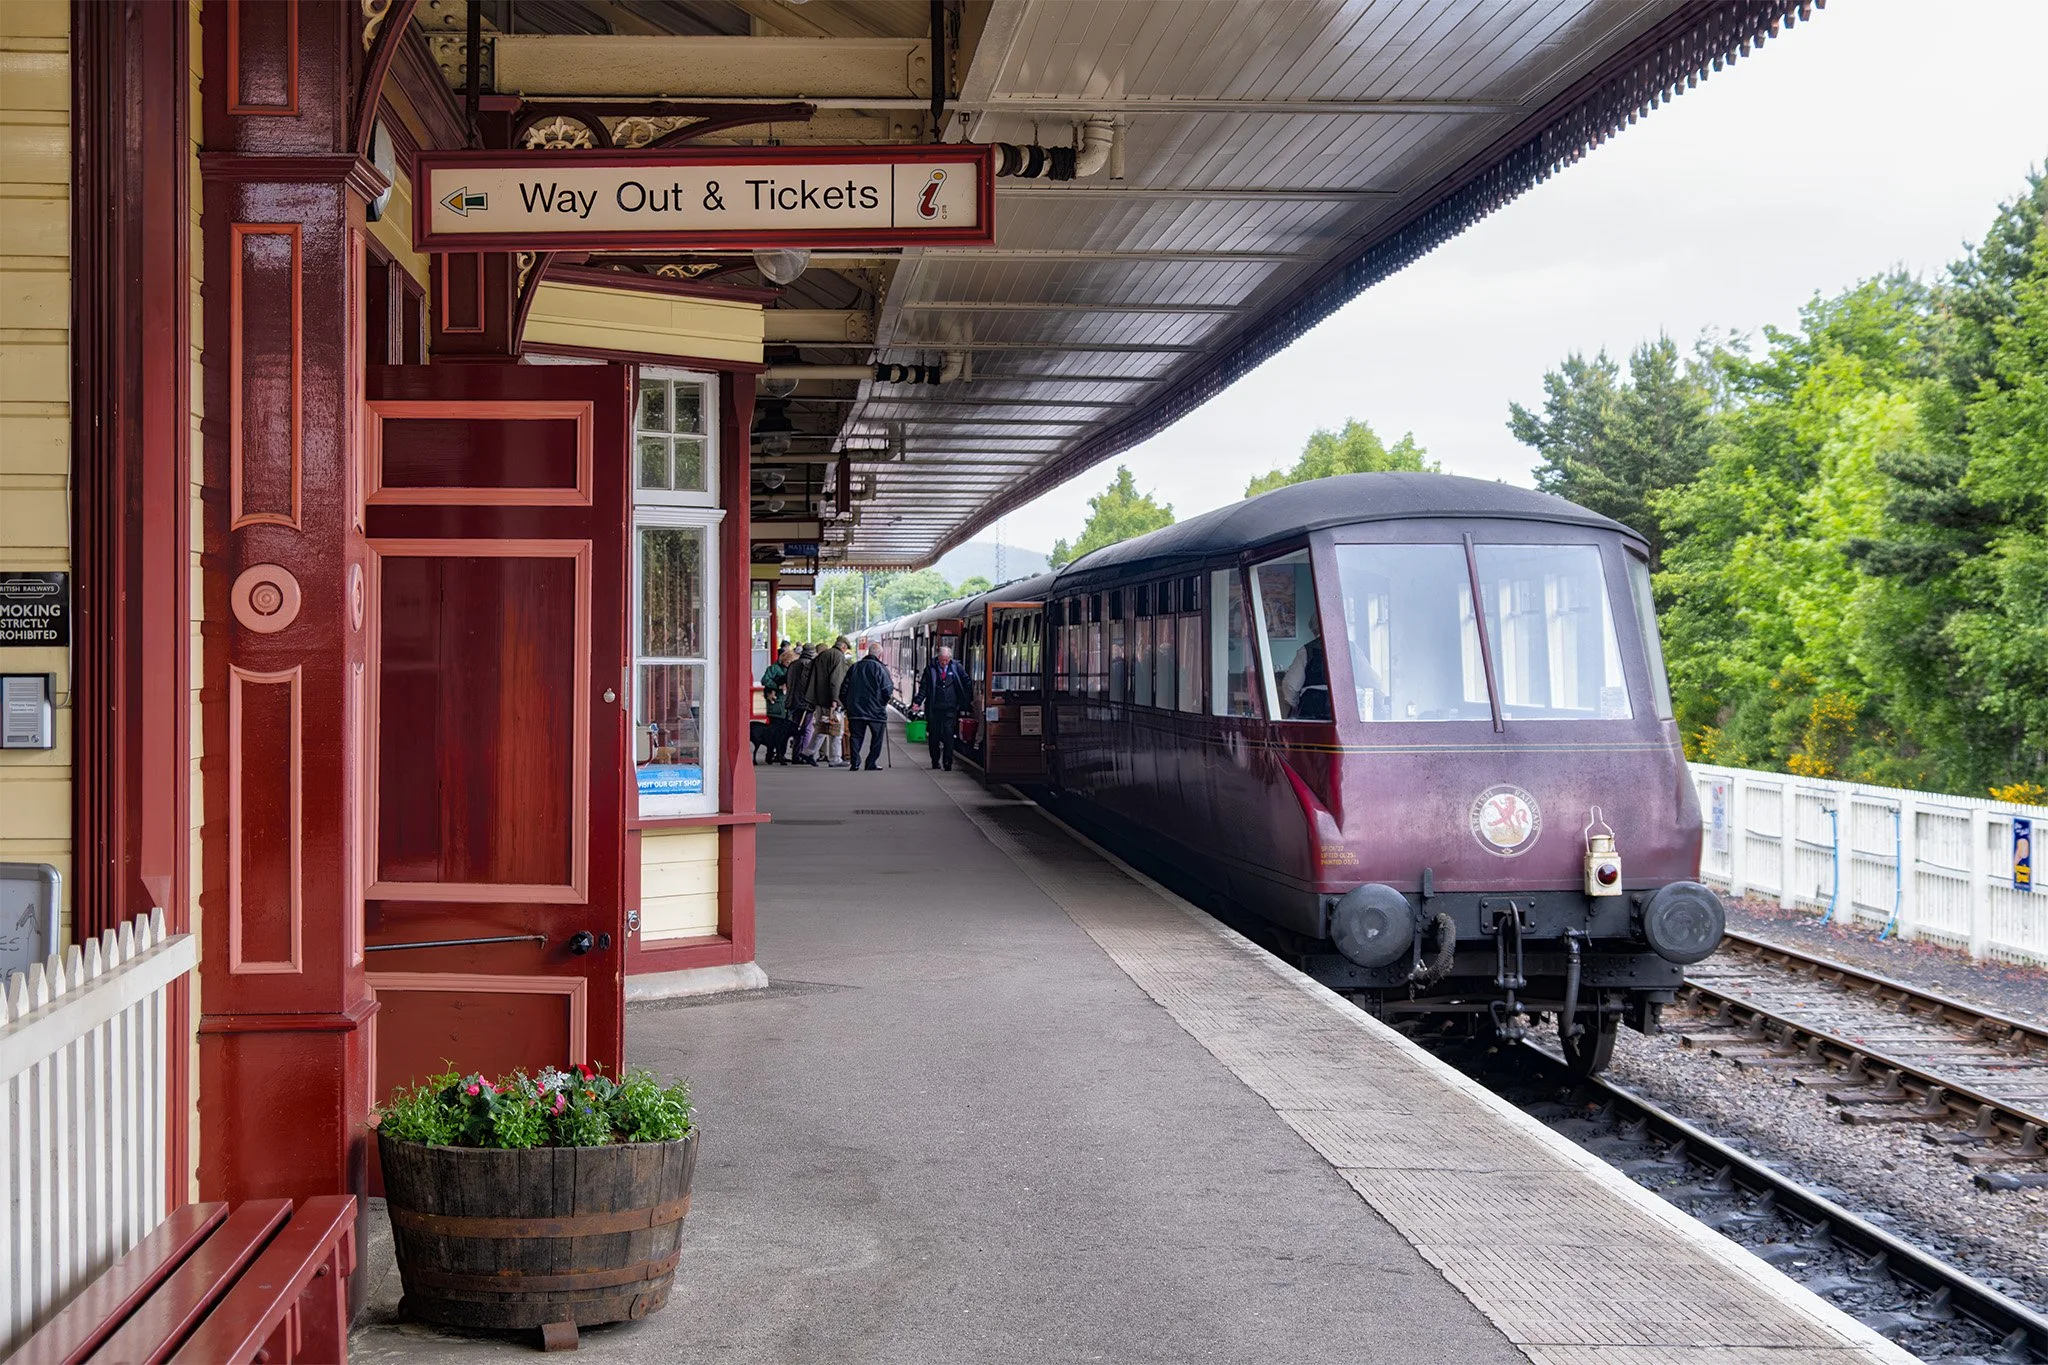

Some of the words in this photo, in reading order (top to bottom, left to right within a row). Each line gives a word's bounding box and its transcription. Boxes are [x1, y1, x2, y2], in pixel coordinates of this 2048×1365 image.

[518, 181, 599, 220] Way
[616, 180, 683, 213] Out
[702, 179, 727, 212] &
[744, 178, 880, 212] Tickets
[0, 604, 61, 617] MOKING
[0, 618, 50, 628] STRICTLY
[0, 629, 58, 640] ROHIBITED
[637, 781, 654, 789] VISIT
[683, 779, 701, 787] SHOP
[1472, 789, 1494, 832] BRITISH
[1514, 789, 1541, 832] RAILWAYS
